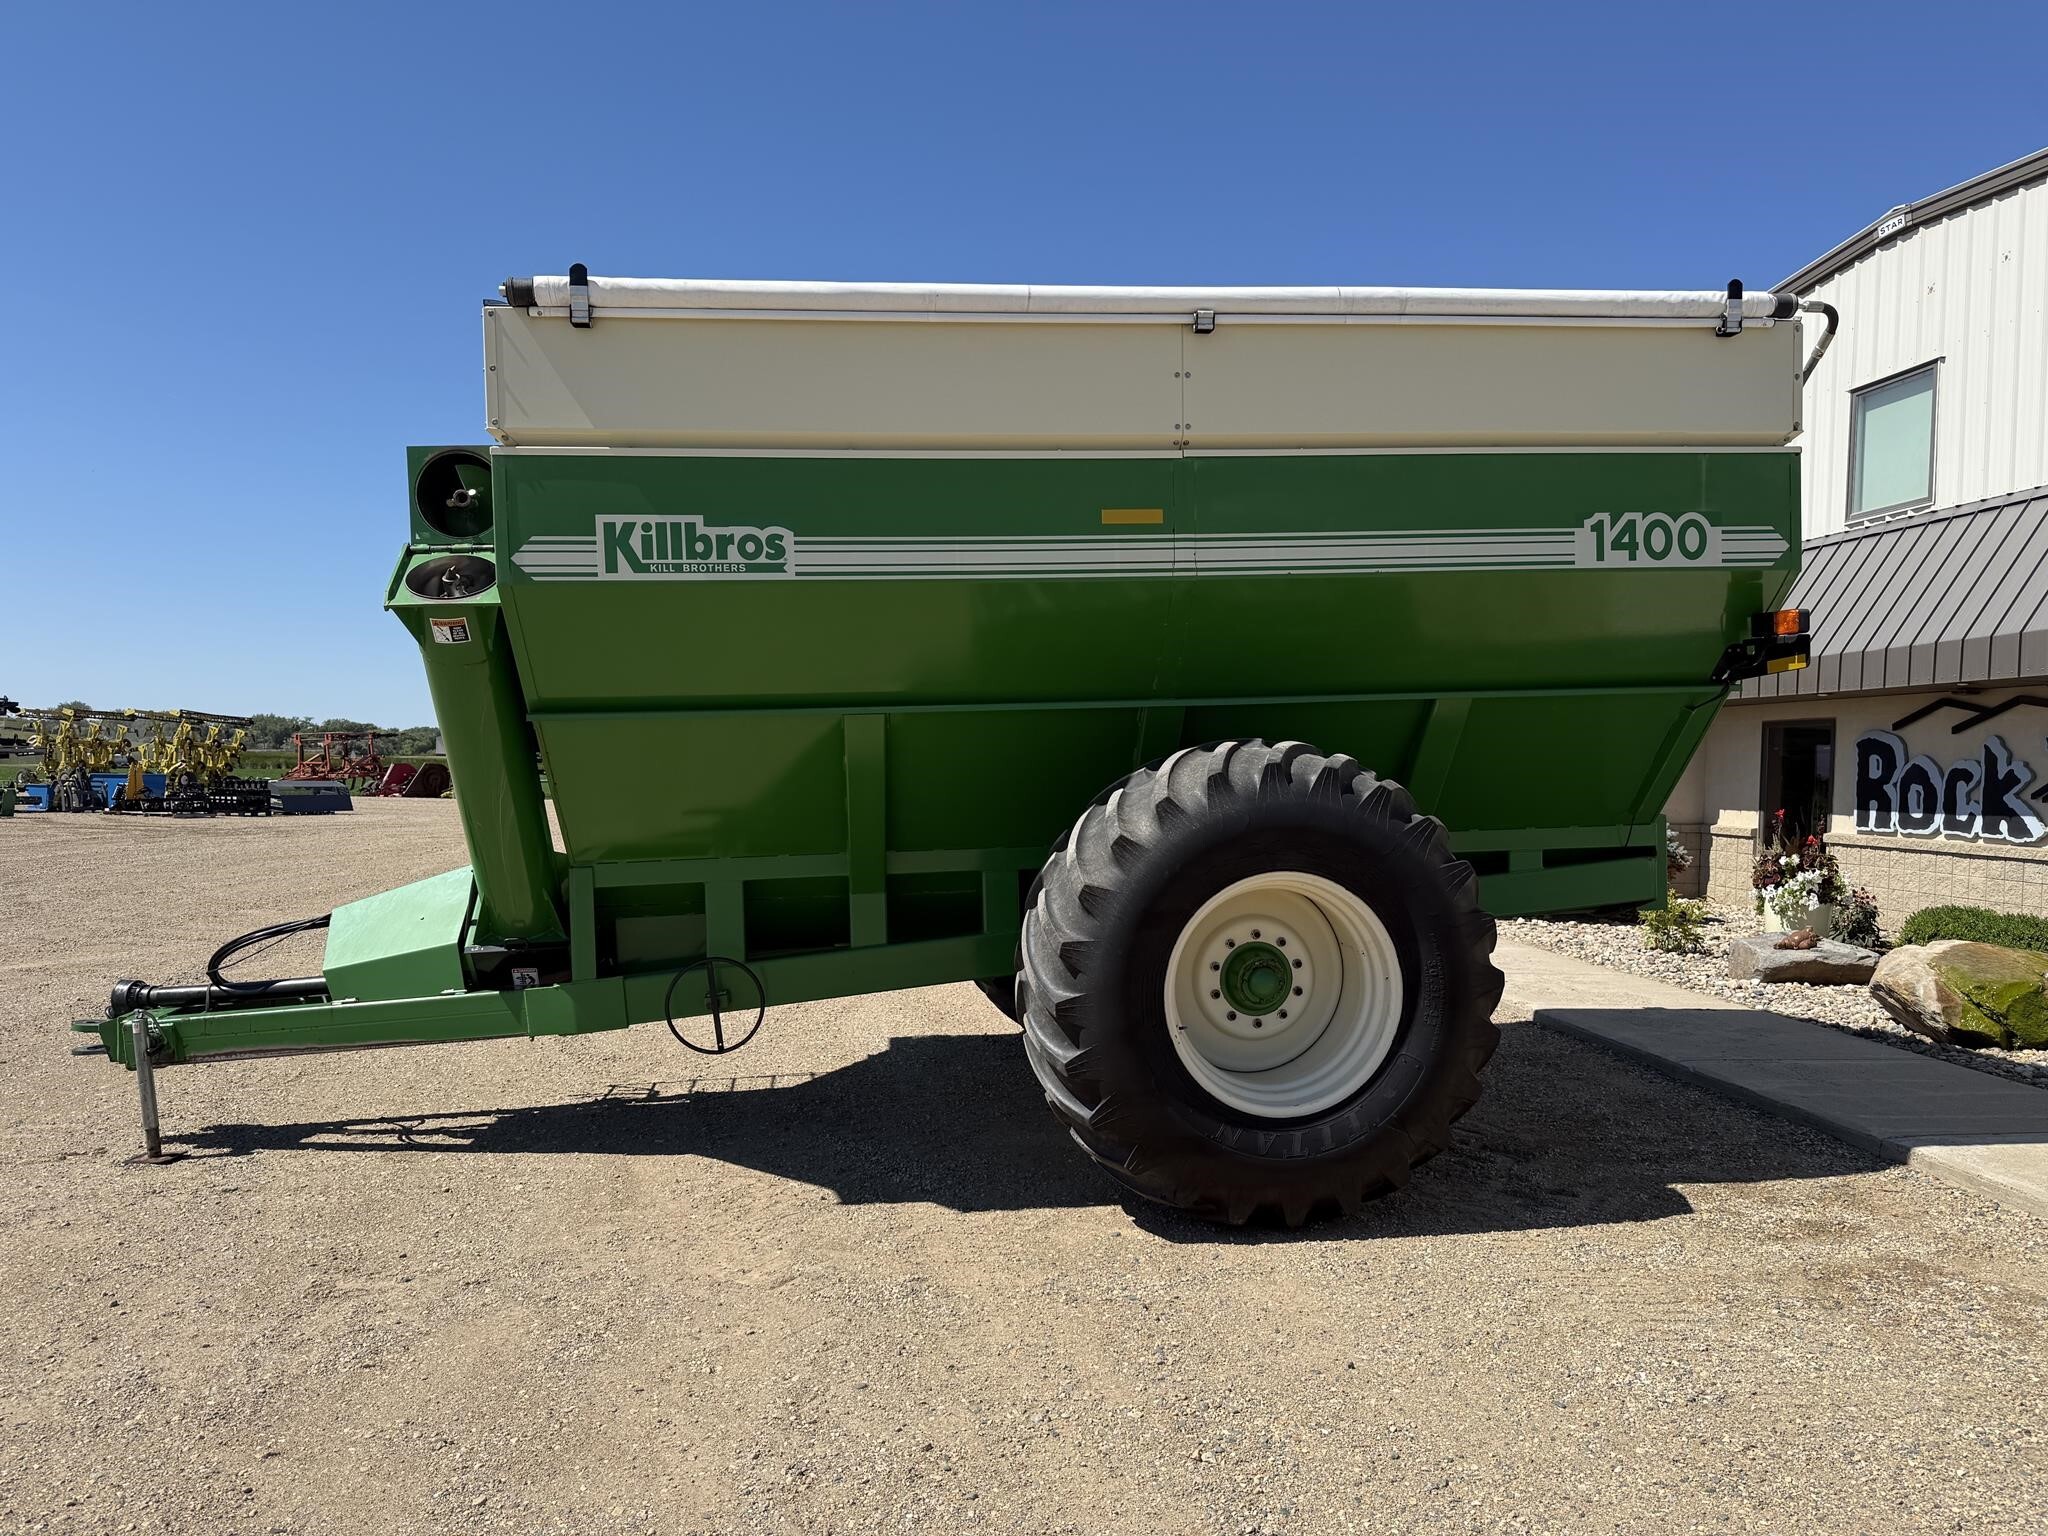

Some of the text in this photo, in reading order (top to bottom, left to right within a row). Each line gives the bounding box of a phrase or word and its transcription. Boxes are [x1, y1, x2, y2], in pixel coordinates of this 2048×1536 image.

[1880, 218, 1903, 235] STAR
[603, 522, 787, 573] Killbros
[1590, 519, 1708, 561] 1400
[650, 563, 747, 573] KILL BROTHERS
[1212, 1106, 1370, 1160] TITAN
